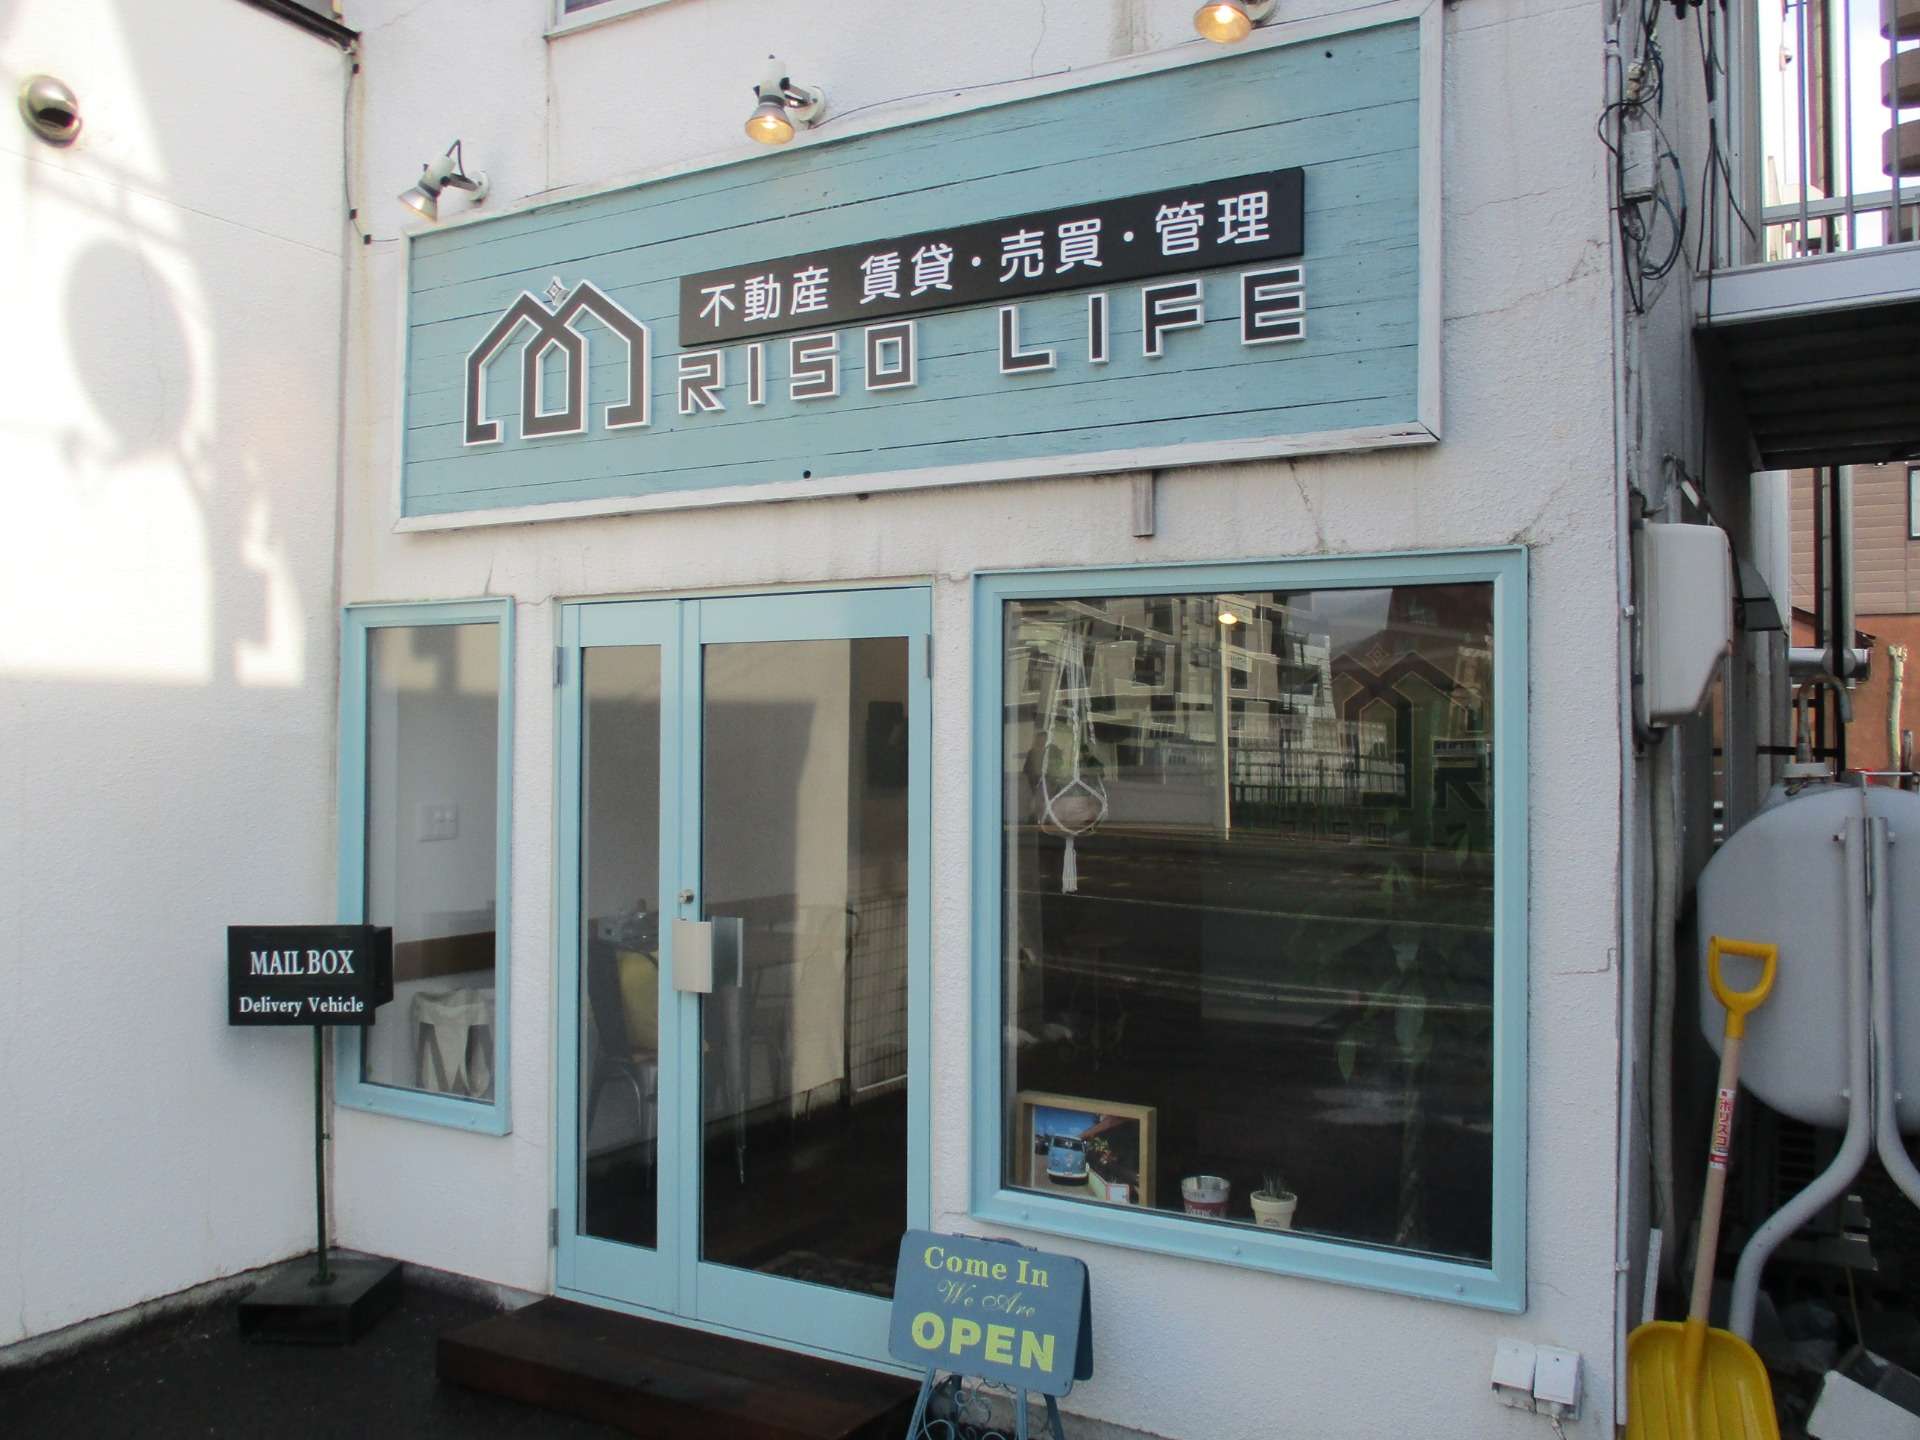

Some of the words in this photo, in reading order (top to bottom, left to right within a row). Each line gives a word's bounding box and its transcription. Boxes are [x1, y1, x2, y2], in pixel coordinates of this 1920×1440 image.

[700, 266, 829, 327] 不動産
[678, 320, 918, 415] RISO
[1000, 264, 1305, 375] LIFE
[250, 950, 304, 976] MAIL
[307, 949, 355, 975] BOX
[239, 996, 302, 1017] Delivery
[308, 996, 364, 1014] Vehicle
[923, 1246, 1008, 1280] Come
[1016, 1259, 1049, 1288] In
[936, 1279, 977, 1307] We
[981, 1291, 1036, 1317] Are
[911, 1311, 1055, 1373] OPEN
